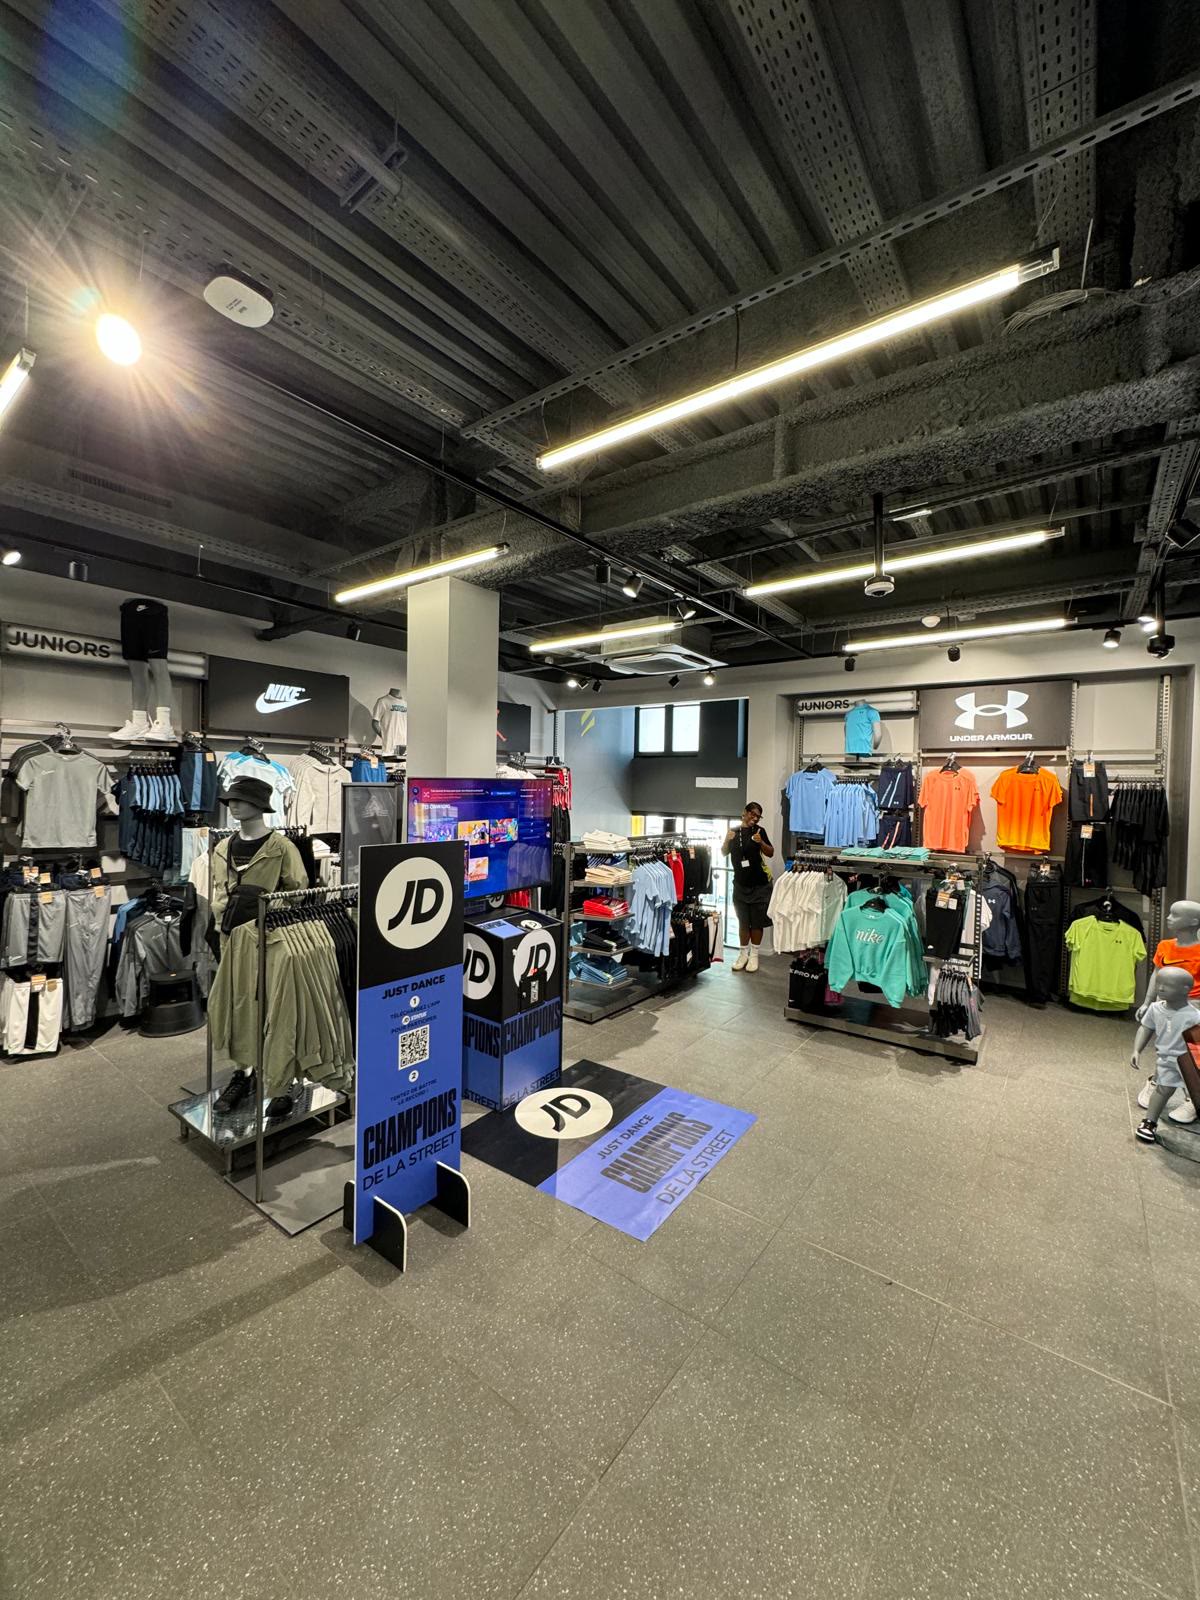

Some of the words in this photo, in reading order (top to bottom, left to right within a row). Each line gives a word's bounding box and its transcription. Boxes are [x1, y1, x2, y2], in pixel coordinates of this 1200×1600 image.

[8, 631, 111, 659] JUNIORS
[264, 683, 305, 702] NIKE
[799, 699, 850, 713] JUNIORS
[985, 733, 1033, 741] ARMOUR
[387, 878, 445, 931] JD
[856, 928, 885, 944] nike
[382, 984, 410, 1000] JUST
[411, 974, 446, 992] DANCE
[413, 997, 418, 1005] 1
[504, 1001, 561, 1055] CHAMPIONS
[517, 1087, 528, 1103] LA
[530, 1070, 561, 1091] STREET
[363, 1087, 457, 1170] CHAMPIONS
[540, 1093, 591, 1133] JD
[597, 1139, 622, 1160] JUST
[622, 1113, 654, 1142] DANCE
[600, 1111, 716, 1194] CHAMPIONS
[363, 1168, 384, 1191] DE
[387, 1159, 406, 1179] LA
[408, 1131, 457, 1167] STREET
[655, 1184, 685, 1205] DE
[675, 1169, 699, 1192] LA
[697, 1129, 736, 1171] STREET
